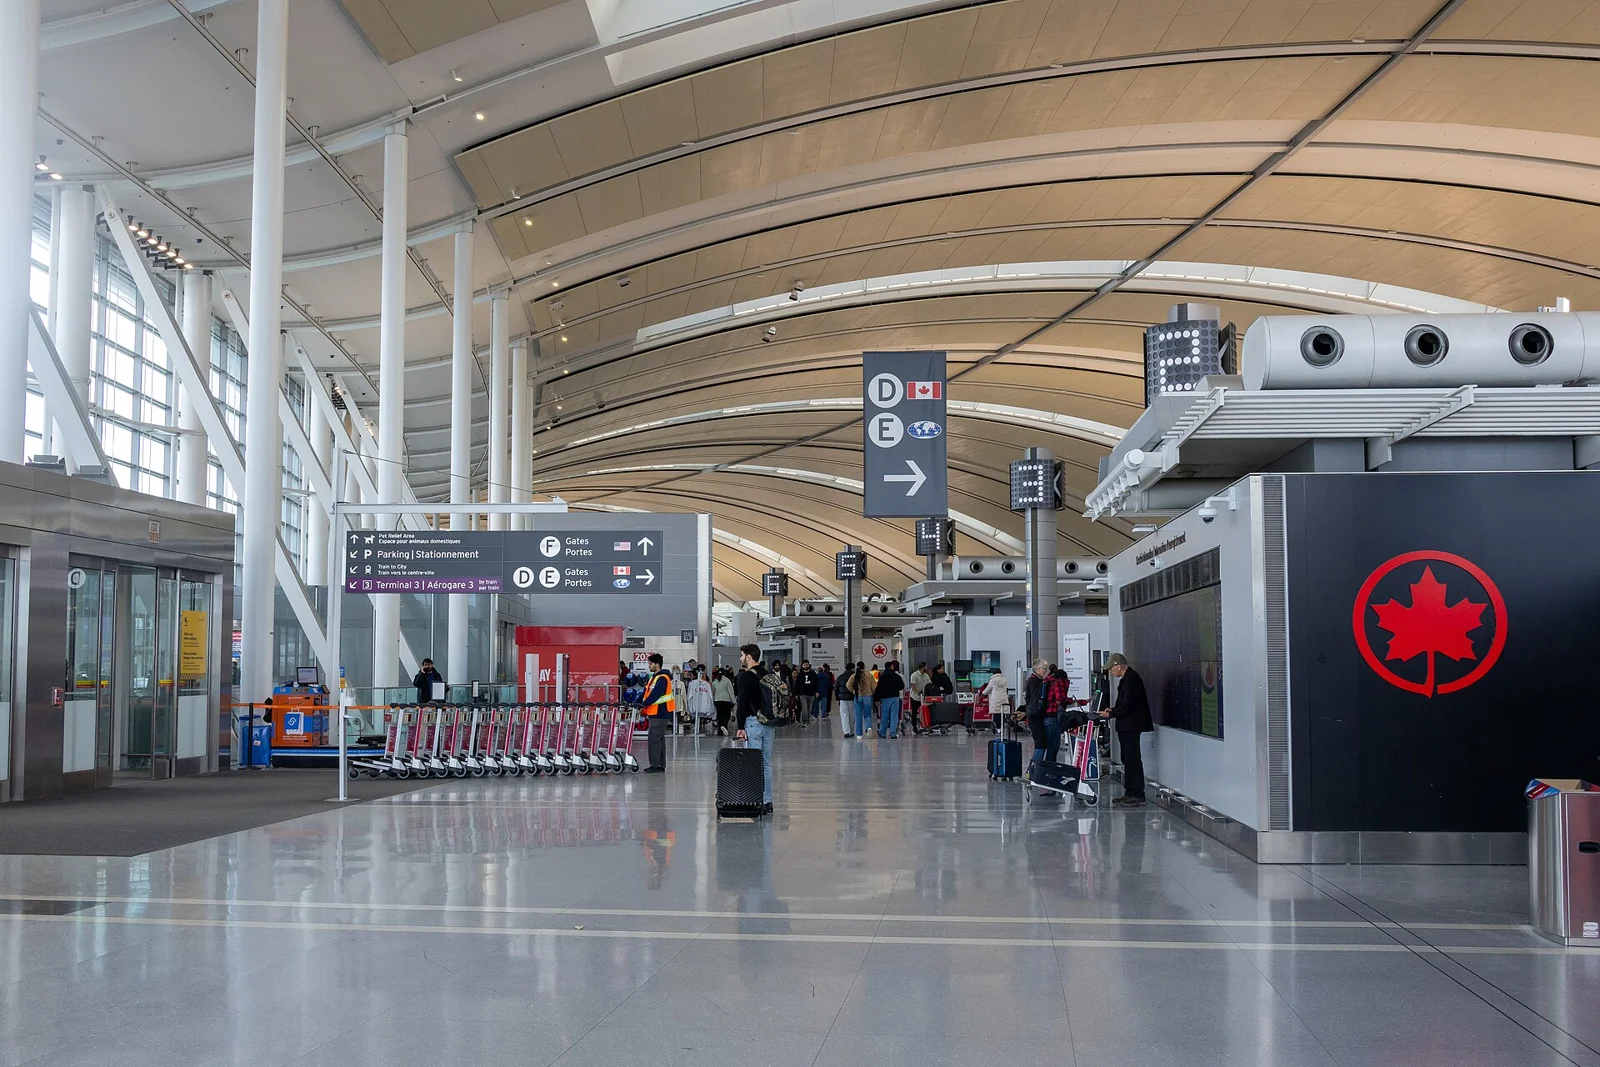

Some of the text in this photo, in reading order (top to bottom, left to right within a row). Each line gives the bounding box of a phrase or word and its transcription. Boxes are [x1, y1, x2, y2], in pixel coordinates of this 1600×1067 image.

[1158, 329, 1201, 393] 2
[878, 378, 897, 402] D
[878, 418, 894, 442] E
[1018, 464, 1044, 503] 3
[565, 537, 589, 545] Gates
[921, 521, 941, 551] 4
[545, 539, 556, 554] F
[565, 548, 593, 556] Portes
[377, 549, 479, 560] Parking Stationnement
[565, 568, 589, 576] Gates
[841, 554, 856, 577] 5
[519, 570, 555, 584] D E
[564, 579, 592, 587] Portes
[376, 580, 412, 589] Terminal
[413, 580, 420, 589] 3
[427, 580, 466, 591] Aérogare
[467, 580, 474, 589] 3
[767, 575, 780, 595] 6
[804, 675, 811, 684] L
